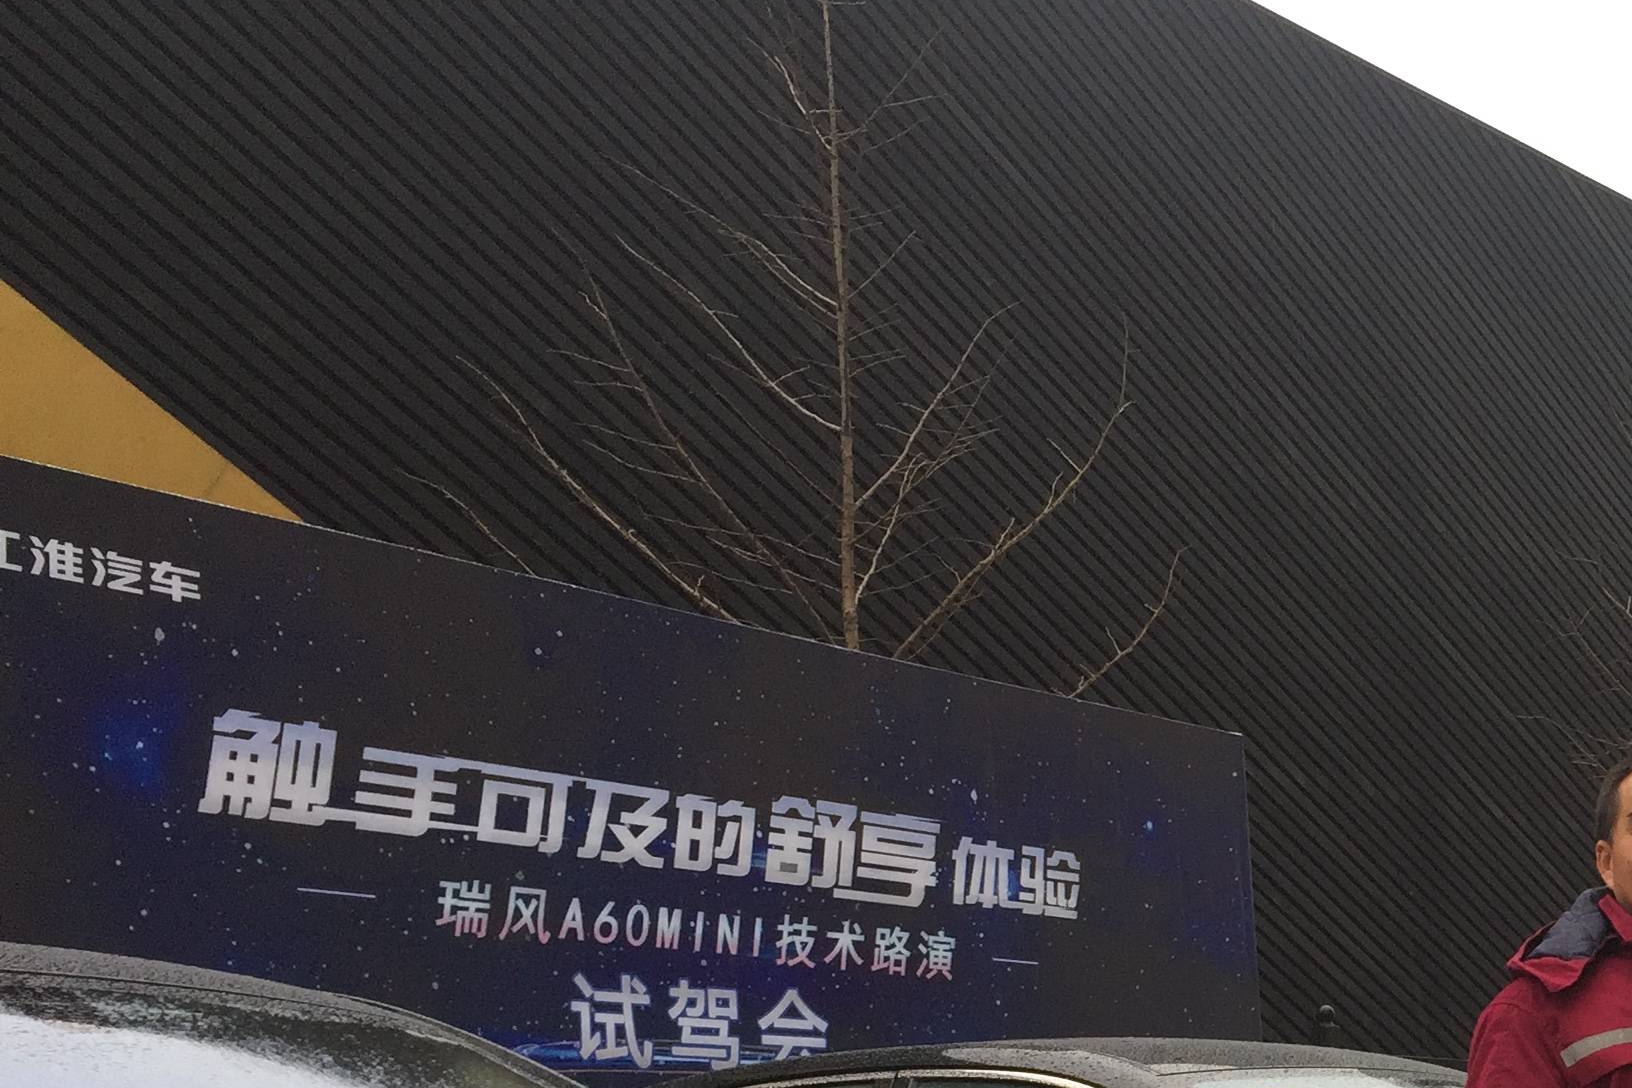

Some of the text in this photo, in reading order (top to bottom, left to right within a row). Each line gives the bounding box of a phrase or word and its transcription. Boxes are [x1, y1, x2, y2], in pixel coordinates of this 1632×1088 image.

[197, 708, 1081, 920] 触手可及的舒享体验
[435, 880, 957, 981] 瑞风A60MINI技术路演
[570, 973, 829, 1069] 试驾会
